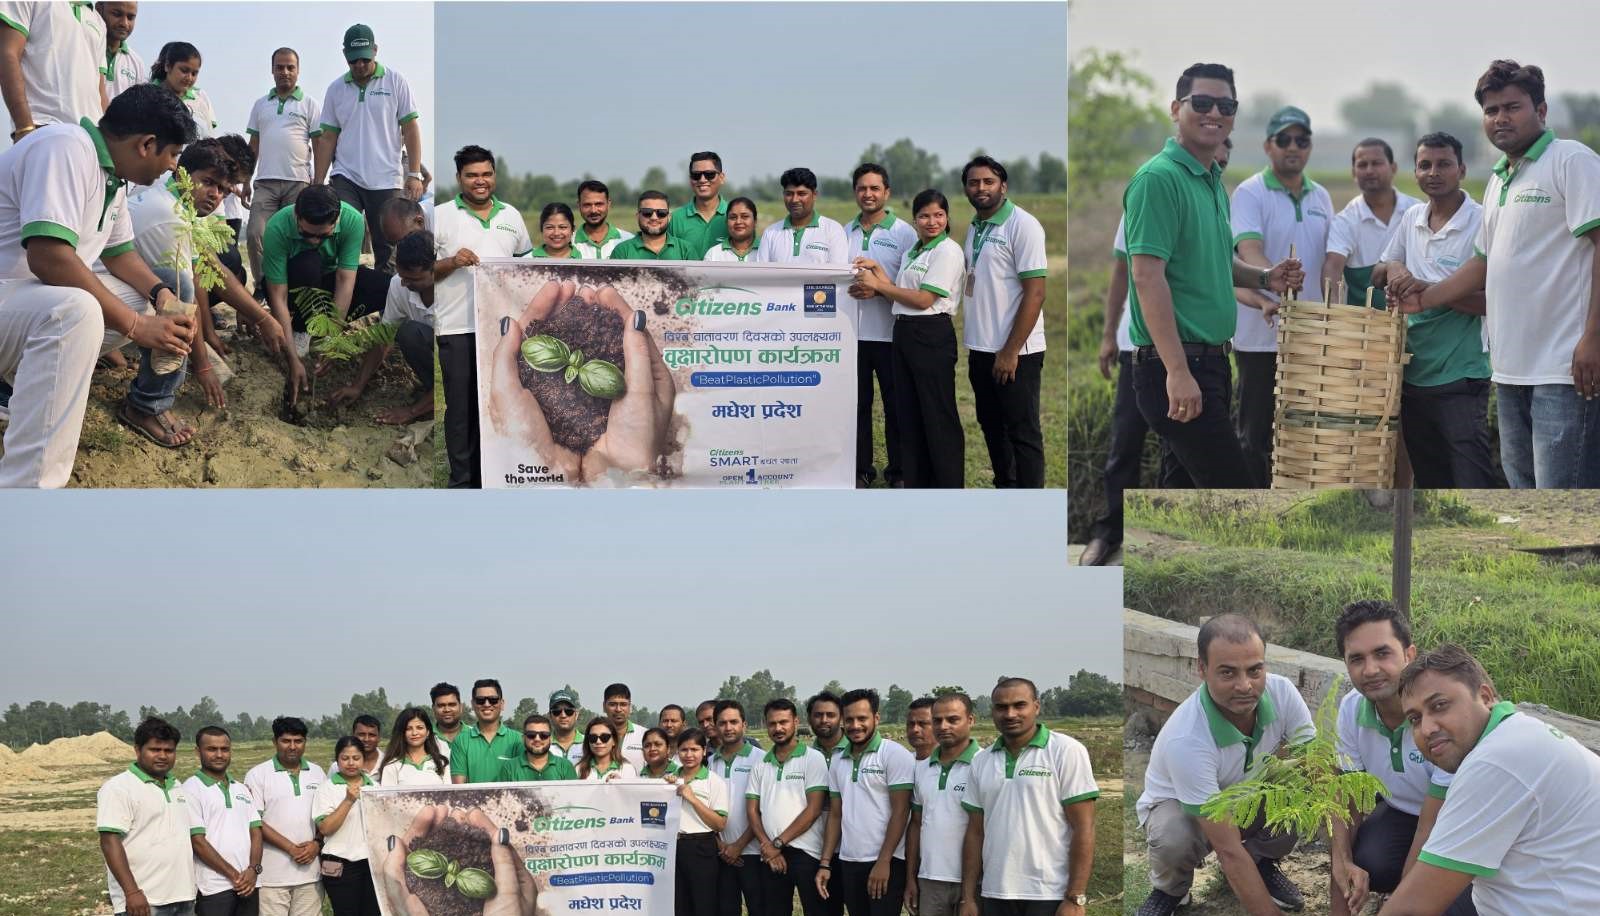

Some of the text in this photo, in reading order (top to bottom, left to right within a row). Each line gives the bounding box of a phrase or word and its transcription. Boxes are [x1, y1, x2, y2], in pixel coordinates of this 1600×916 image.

[1514, 194, 1552, 204] Citizens
[806, 243, 829, 252] Citizens
[873, 239, 898, 250] Citizens
[675, 297, 797, 316] Citizens Bank
[693, 332, 738, 342] वातावरण
[743, 329, 785, 342] दिवसको
[789, 332, 841, 342] उपलक्ष्यमा
[664, 345, 841, 368] वृक्षारोपण कार्यक्रम
[712, 401, 802, 418] मधेश प्रदेश
[710, 456, 759, 467] SMART
[518, 464, 549, 474] Save
[505, 474, 564, 484] the world
[746, 468, 758, 485] 1
[1018, 769, 1052, 777] Citizens
[534, 815, 635, 833] Citizens Bank
[550, 841, 588, 852] वातावरण
[591, 838, 627, 849] दिवसको
[526, 850, 667, 873] वृक्षारोपण कार्यक्रम
[568, 895, 642, 911] मधेश प्रदेश
